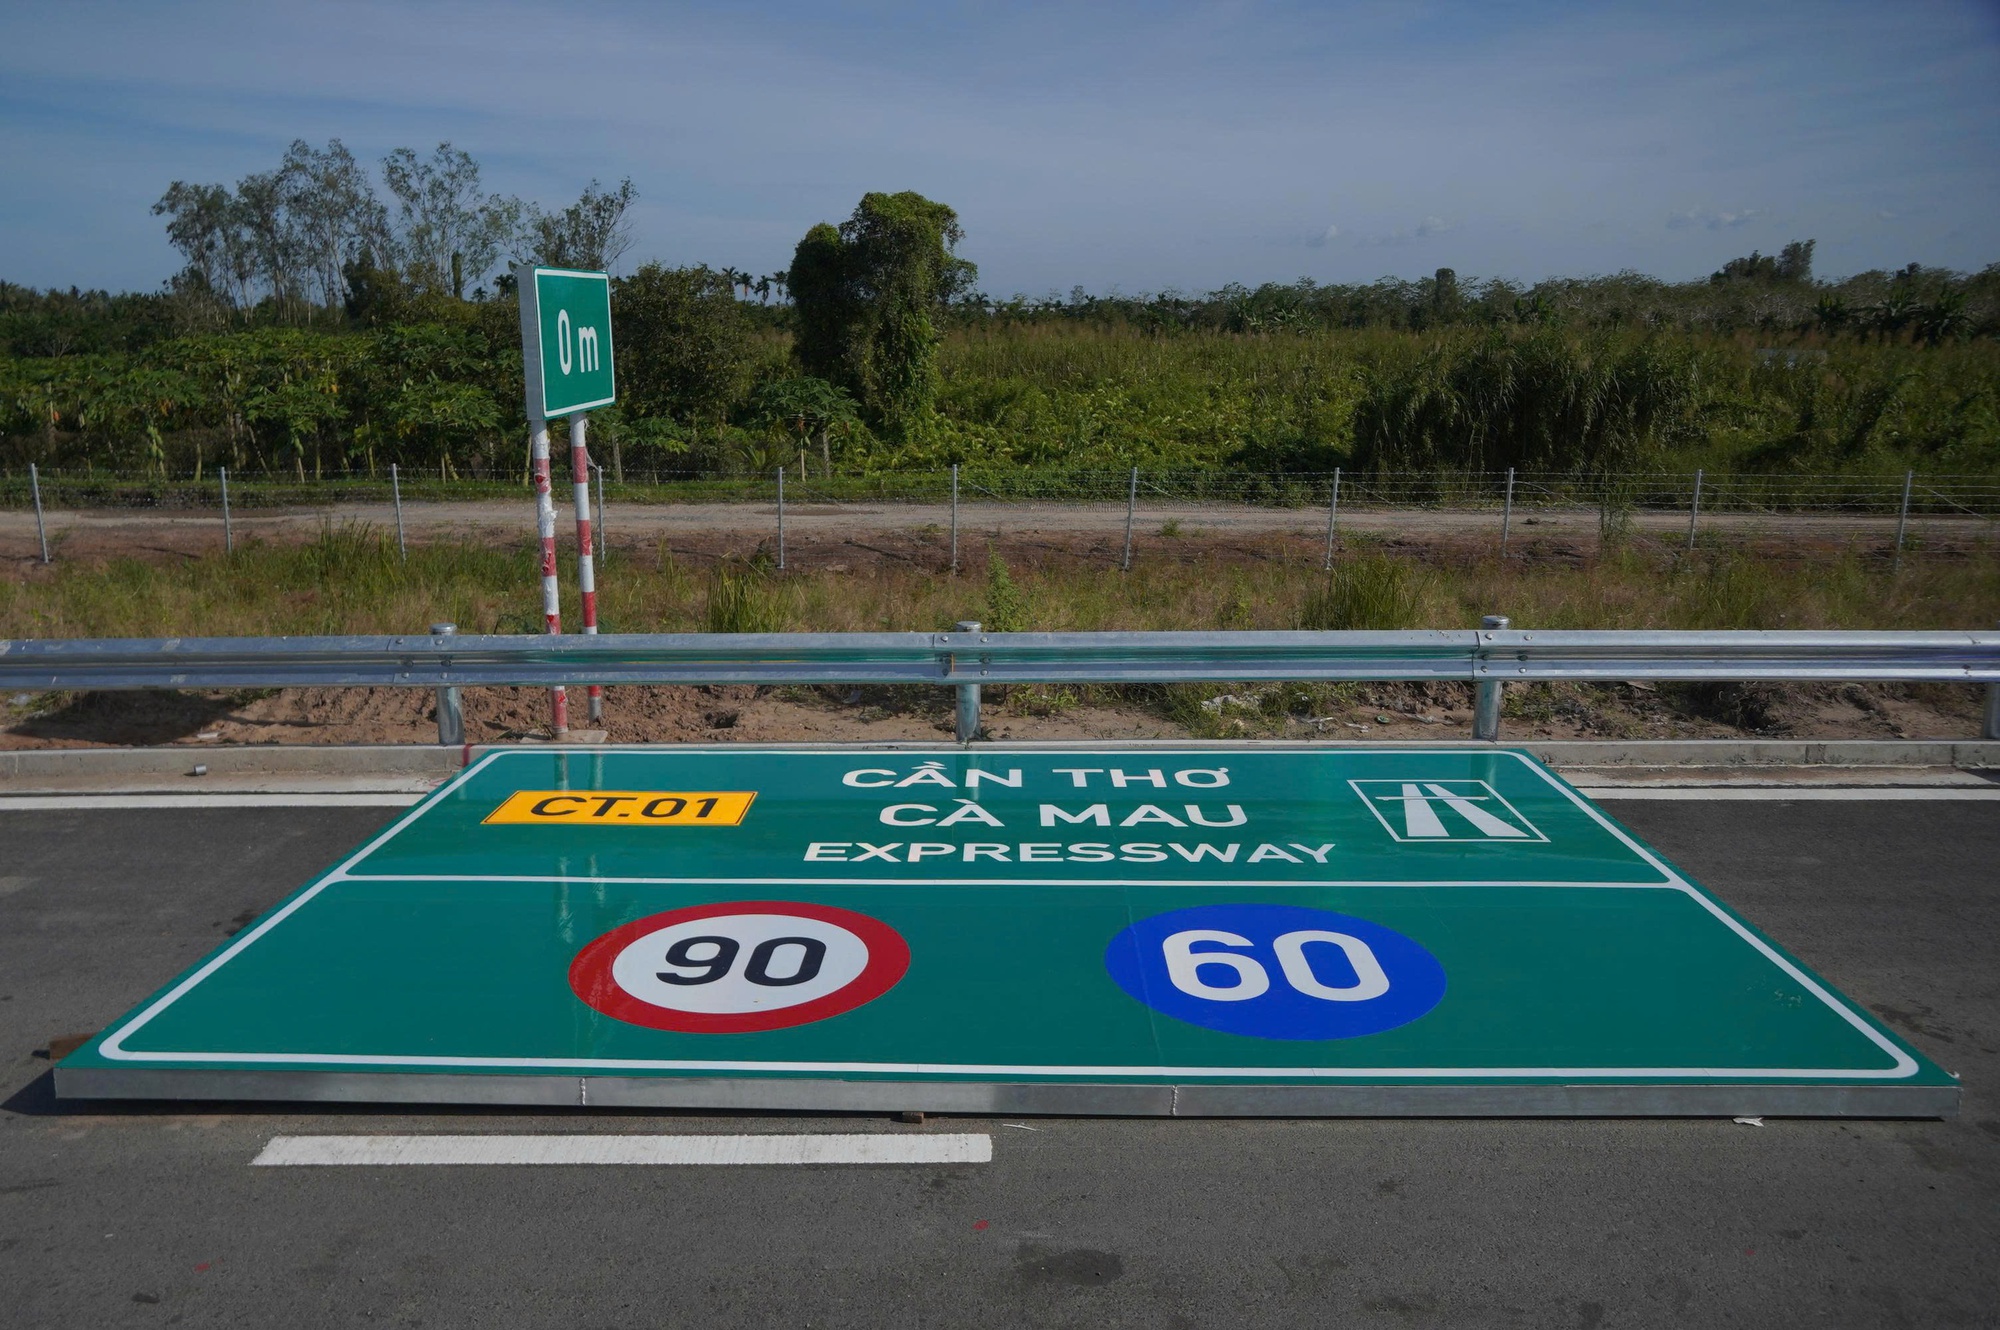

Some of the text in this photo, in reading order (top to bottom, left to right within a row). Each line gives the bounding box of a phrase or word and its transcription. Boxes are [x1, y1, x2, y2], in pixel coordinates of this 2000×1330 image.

[558, 309, 599, 375] 0 m
[842, 761, 1231, 788] CẦN THƠ
[530, 796, 719, 818] CT.01
[879, 798, 1248, 828] CÀ MAU
[803, 842, 1336, 863] EXPRESSWAY
[656, 936, 827, 986] 90
[1162, 929, 1390, 1001] 60
